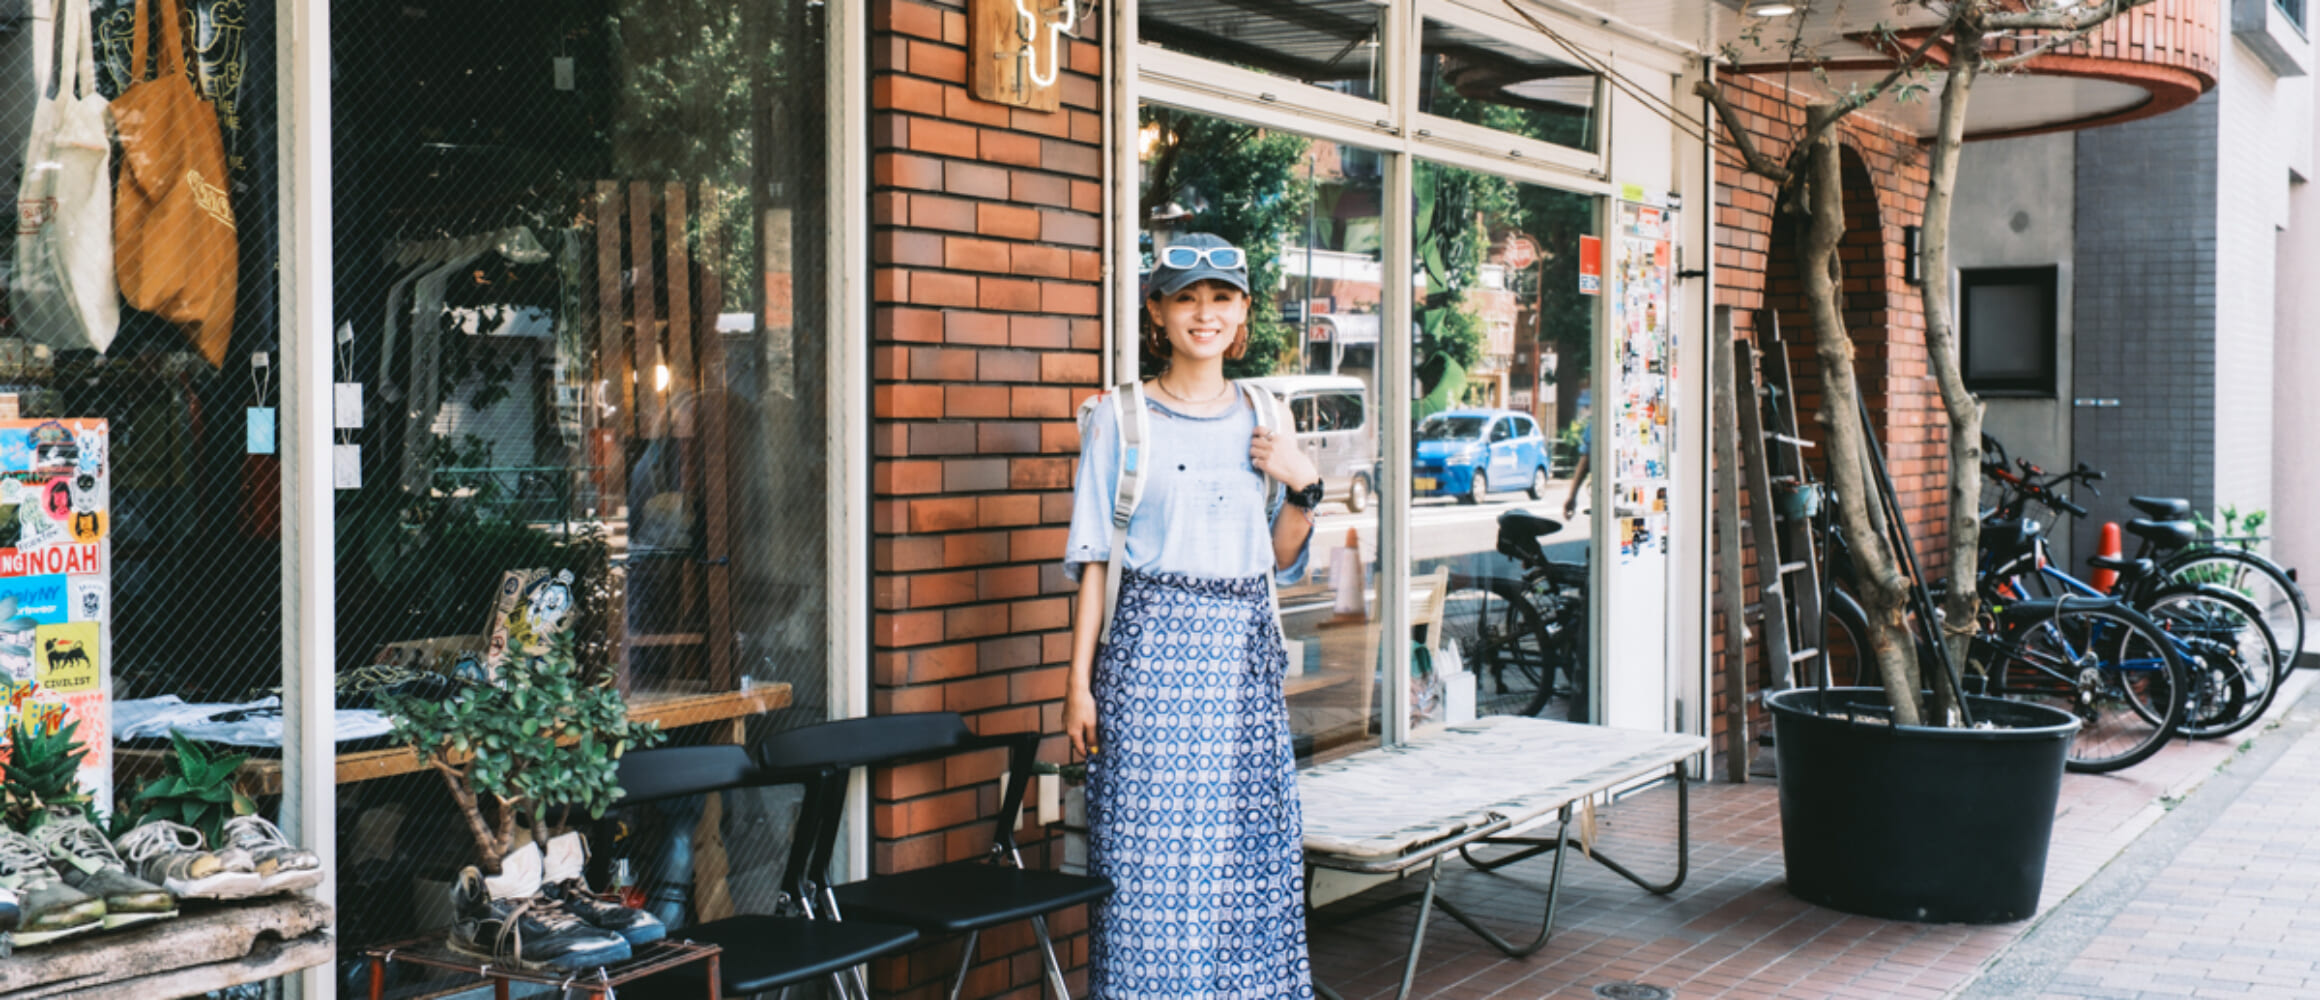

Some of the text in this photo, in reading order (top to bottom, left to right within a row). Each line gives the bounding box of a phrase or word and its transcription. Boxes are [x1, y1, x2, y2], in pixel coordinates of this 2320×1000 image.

[0, 545, 97, 575] NG NOAH
[44, 676, 91, 689] CIVILIST
